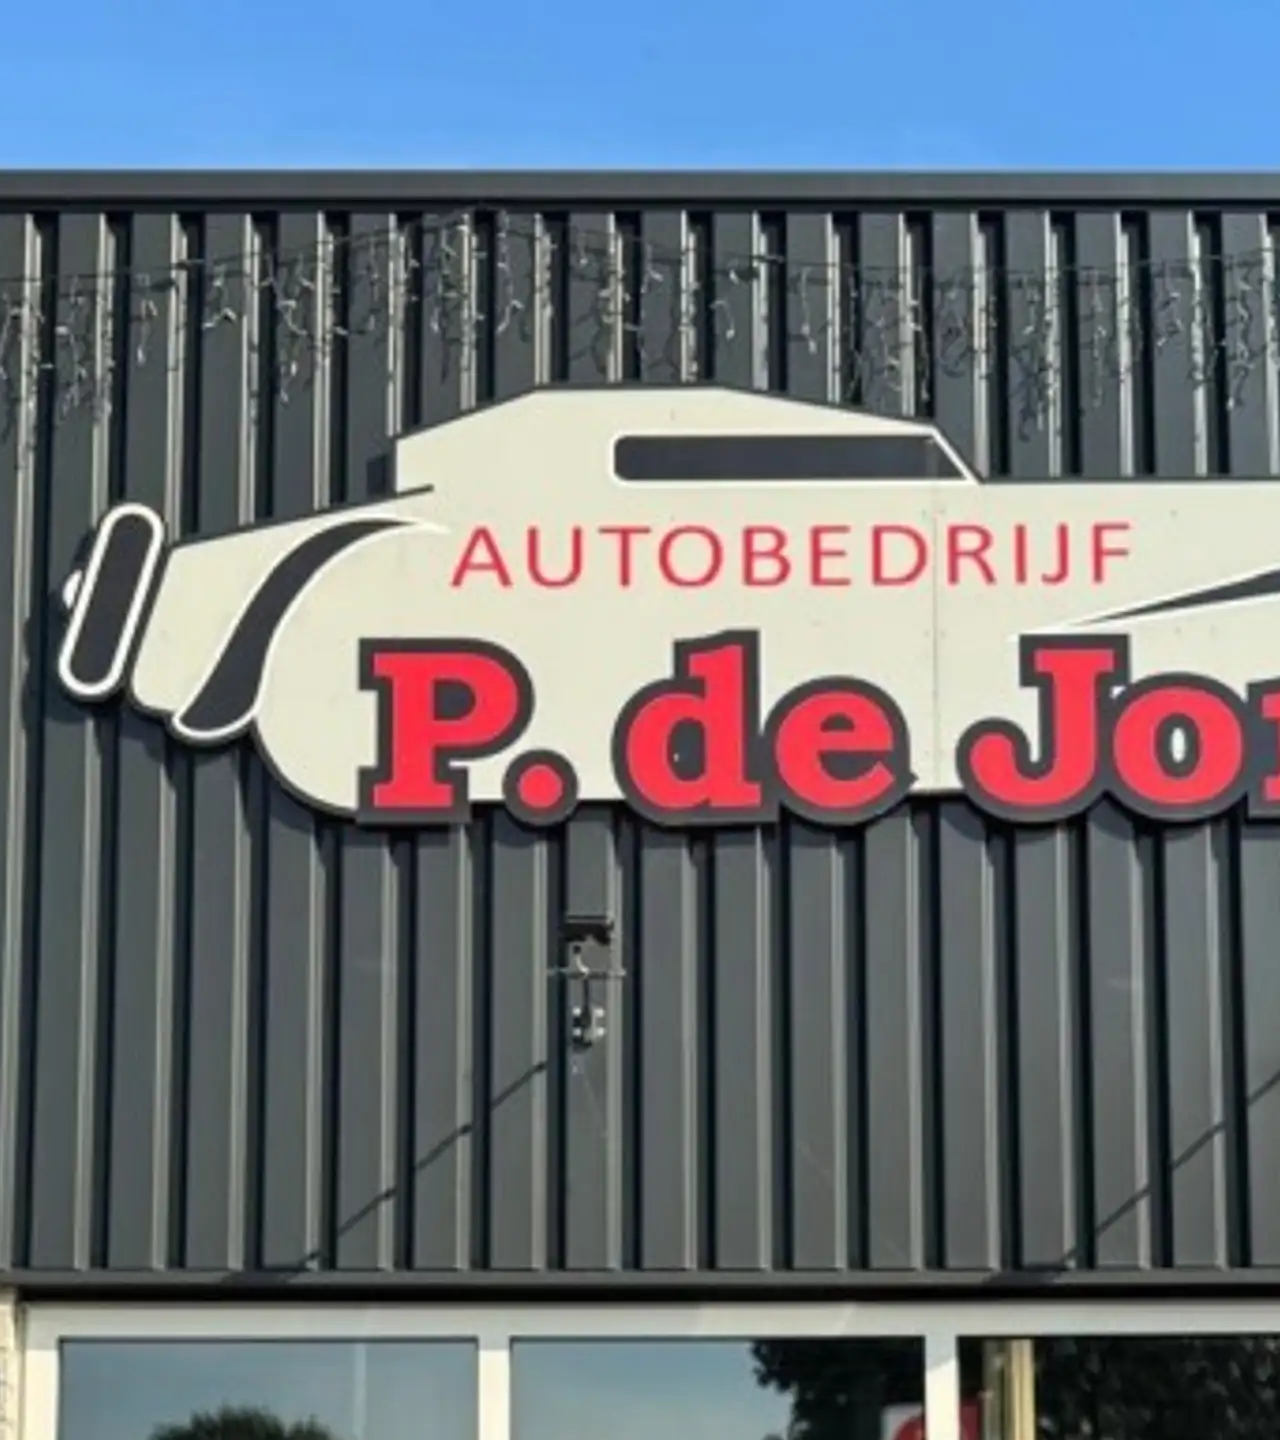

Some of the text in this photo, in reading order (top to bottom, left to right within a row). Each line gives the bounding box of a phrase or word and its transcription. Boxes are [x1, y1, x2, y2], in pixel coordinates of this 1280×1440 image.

[450, 523, 1132, 589] AUTOBEDRIJF
[360, 640, 577, 820] P.
[615, 632, 908, 821] de
